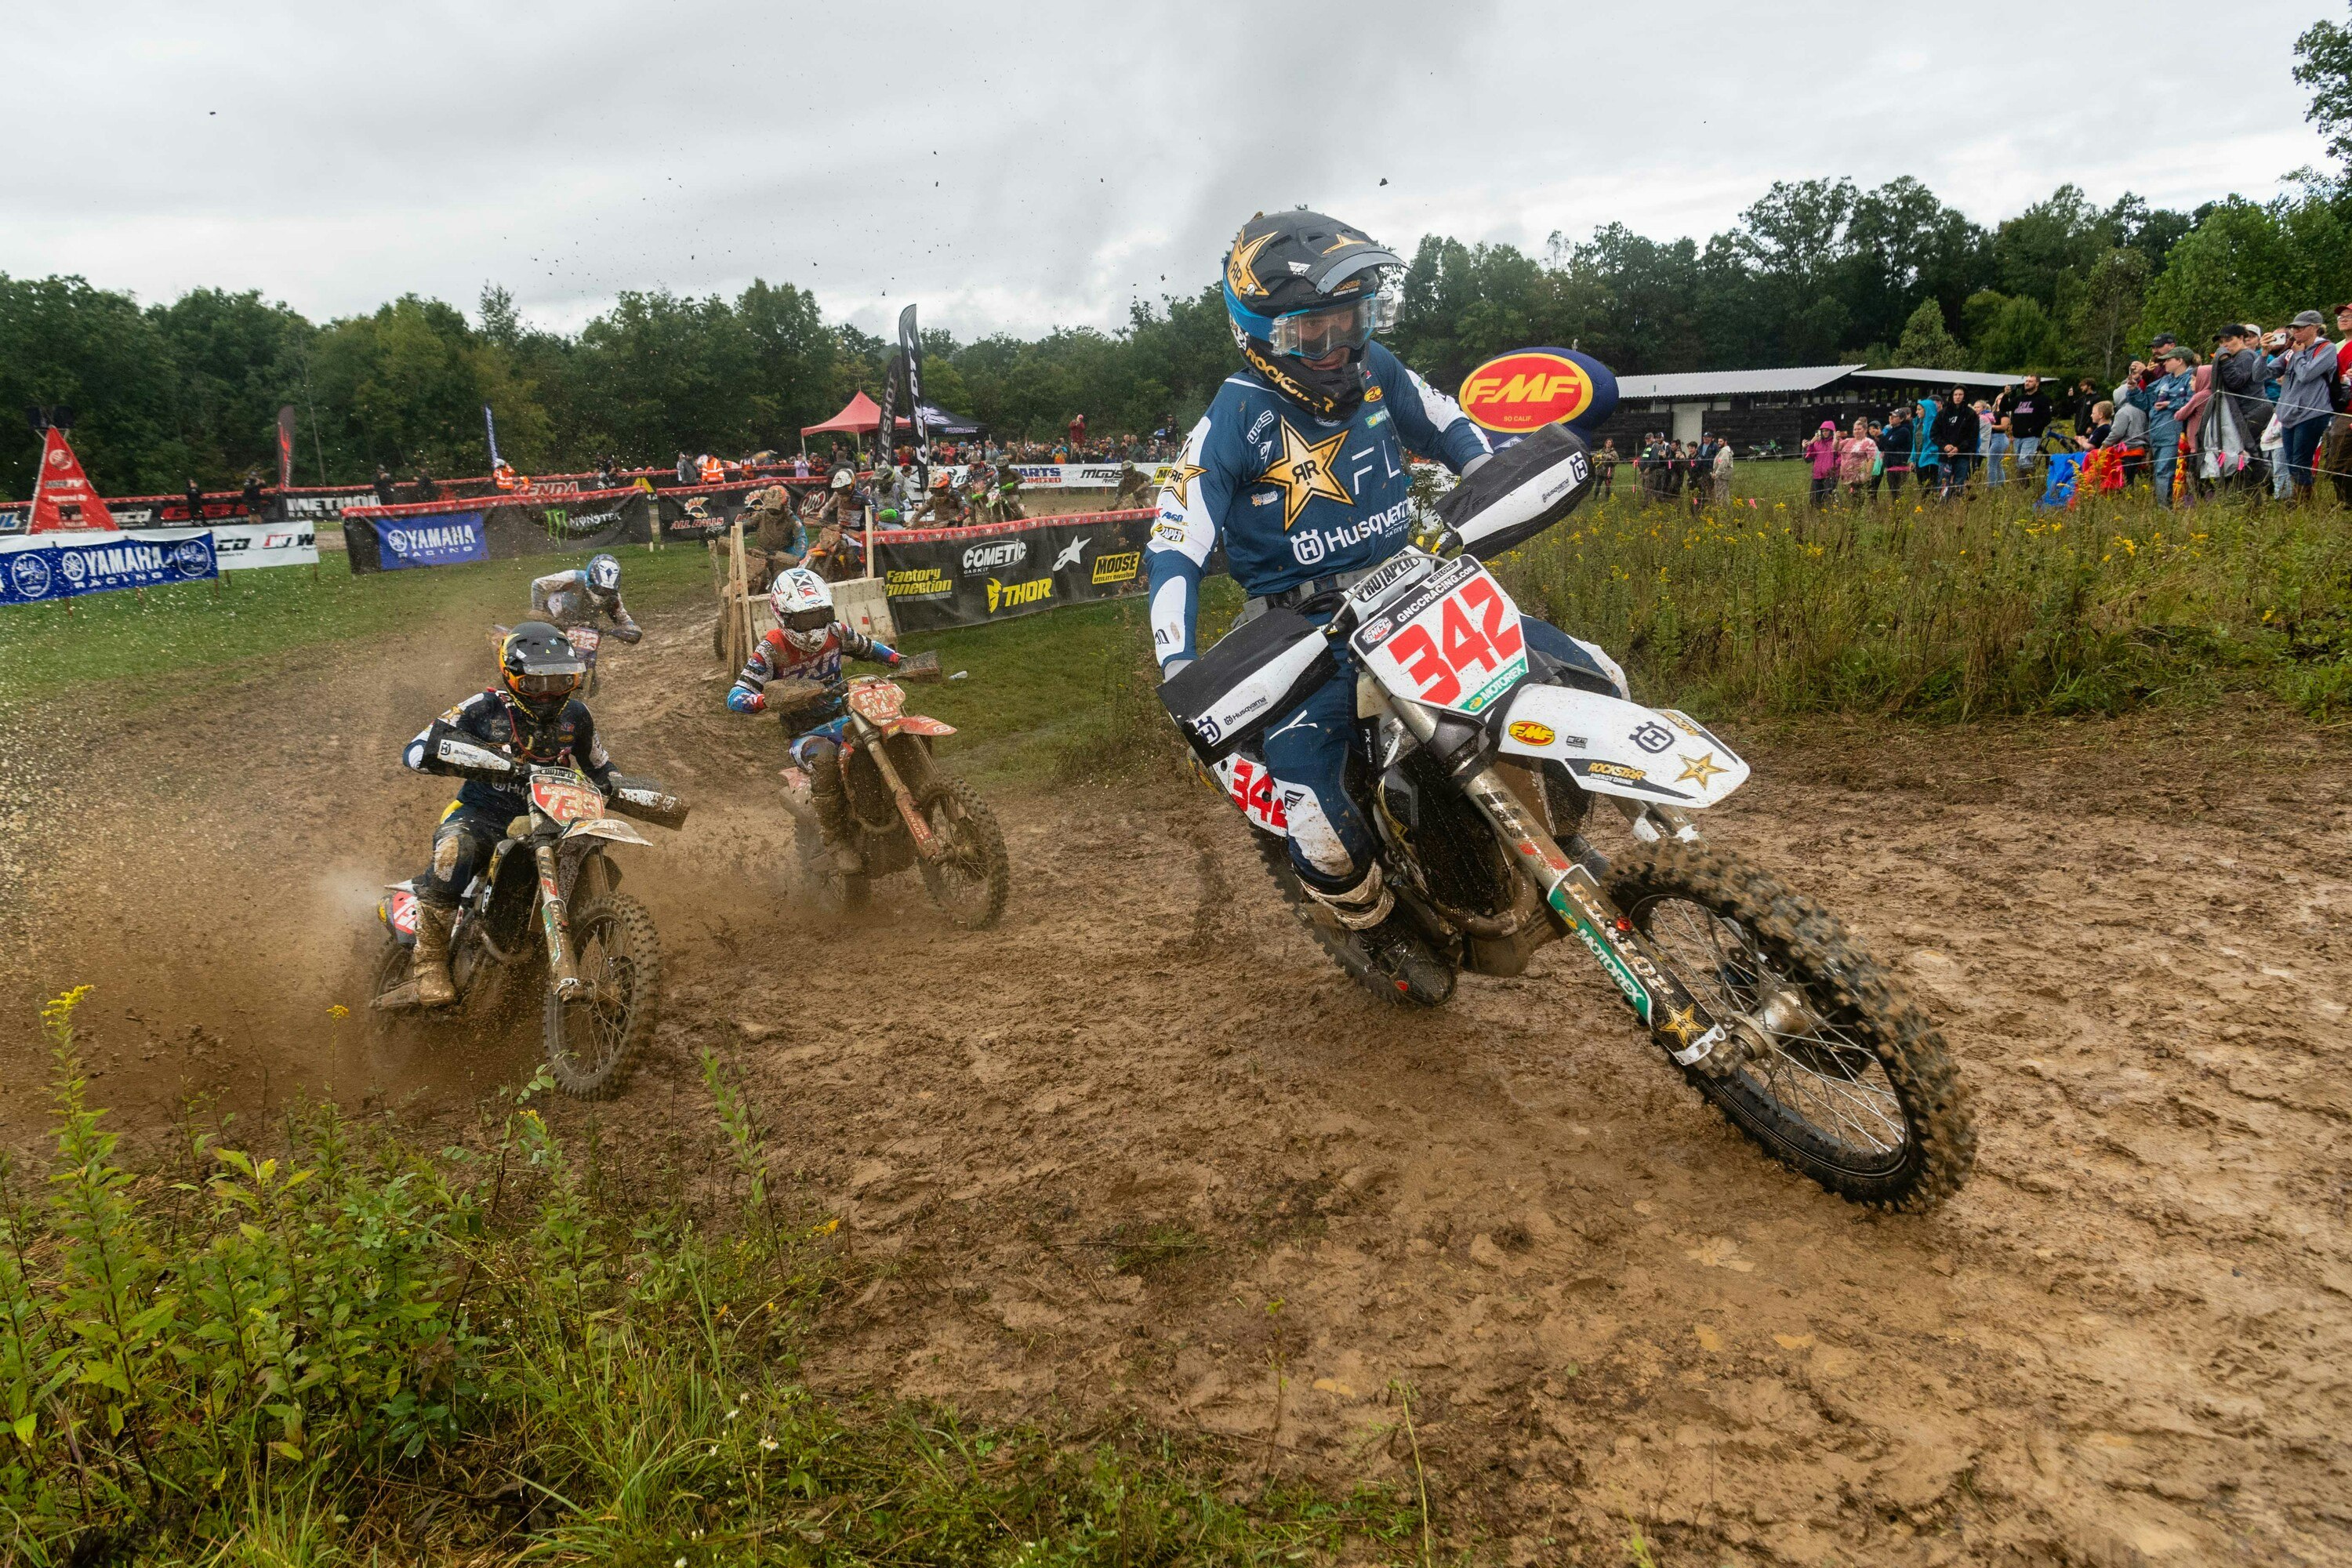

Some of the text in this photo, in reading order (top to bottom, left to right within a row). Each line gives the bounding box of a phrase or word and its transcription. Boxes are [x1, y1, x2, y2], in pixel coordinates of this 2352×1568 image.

[1247, 347, 1335, 413] ROCKR
[1465, 372, 1581, 406] FMF
[881, 373, 895, 461] LESHOT
[512, 481, 579, 495] KENDA
[569, 512, 622, 528] MONSTER
[670, 519, 691, 529] ALL
[406, 524, 475, 549] YAMAHA
[84, 546, 168, 577] YAMAHA
[398, 546, 474, 558] RACING
[963, 541, 1027, 569] COMETIC
[887, 568, 942, 583] Factory
[1096, 554, 1138, 575] MOOSE
[1432, 564, 1456, 581] DELONG
[74, 572, 163, 588] RACING
[1002, 577, 1053, 608] THOR
[1396, 564, 1475, 622] GNCCRACING.COM
[1387, 576, 1523, 706] 342
[1481, 664, 1526, 701] MOTOREX
[1232, 697, 1267, 720] Husqvarna
[1508, 722, 1555, 741] FMF
[1588, 761, 1647, 781] ROCKSTAR
[1577, 927, 1644, 1004] MOTOREX
